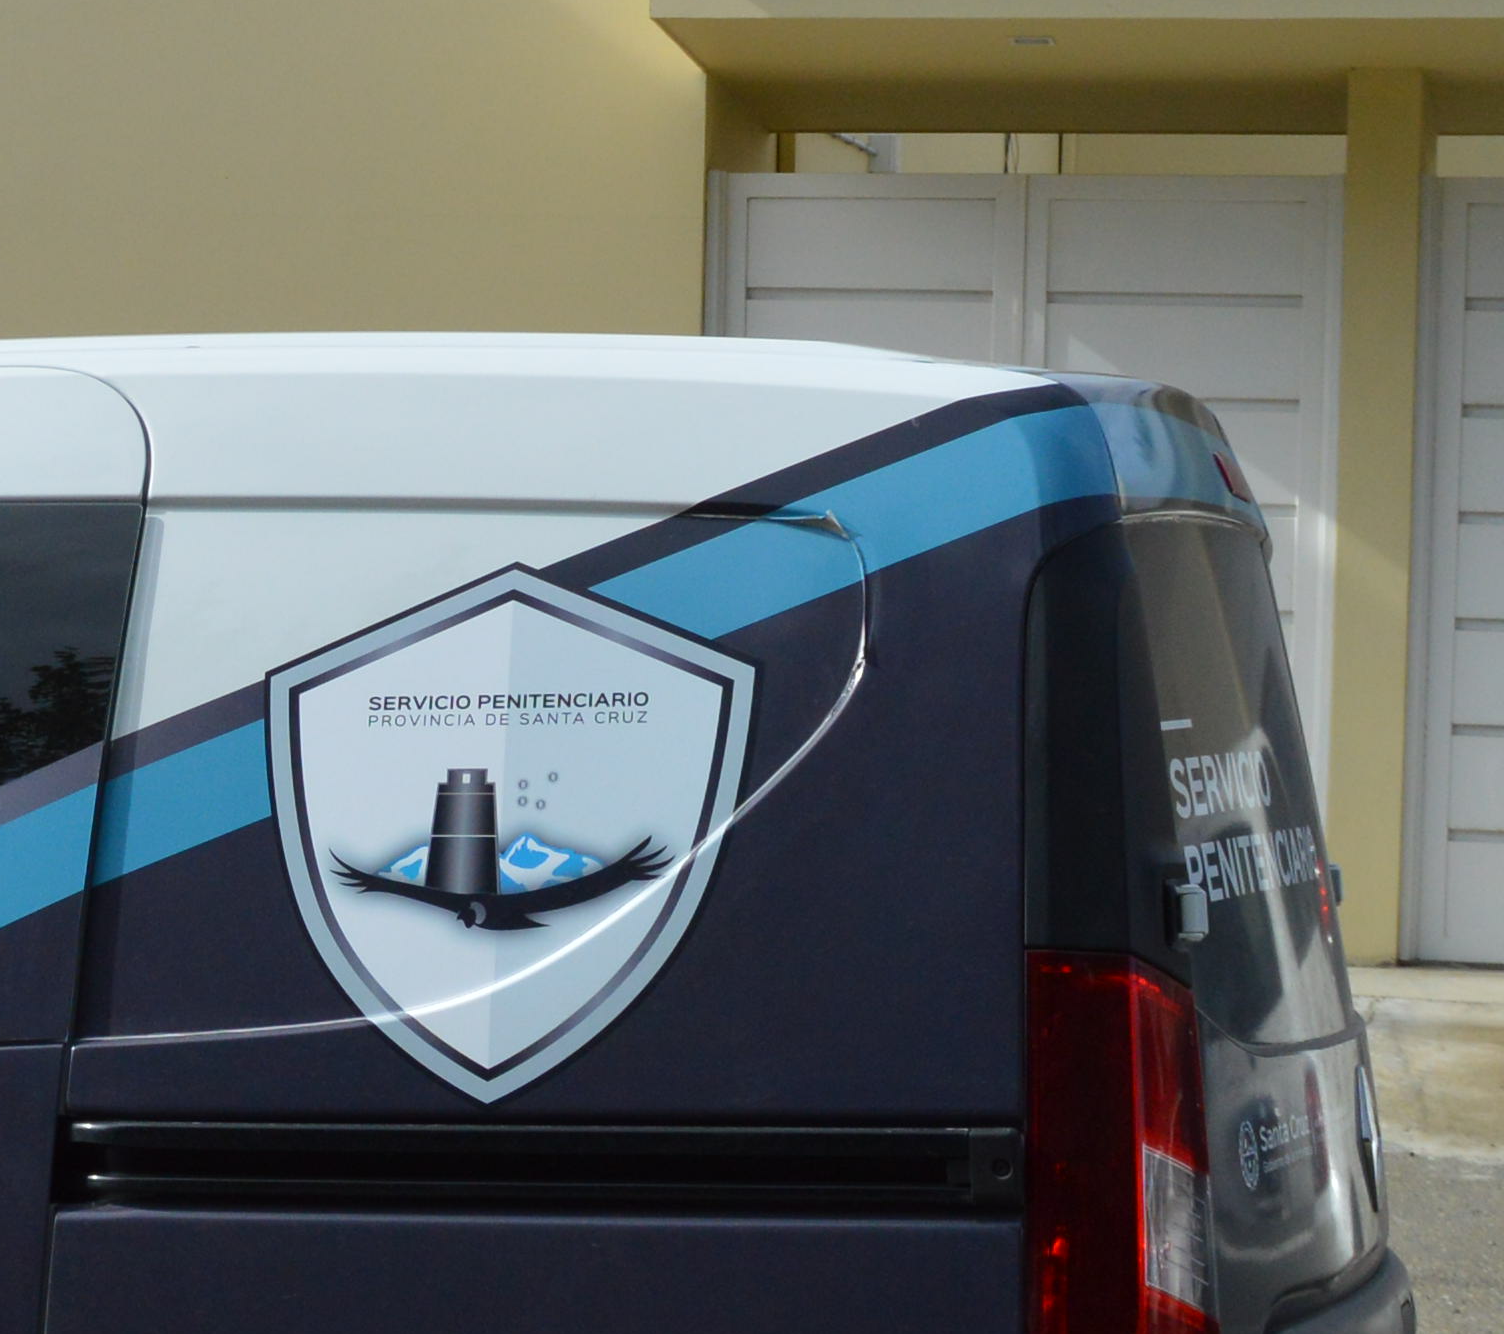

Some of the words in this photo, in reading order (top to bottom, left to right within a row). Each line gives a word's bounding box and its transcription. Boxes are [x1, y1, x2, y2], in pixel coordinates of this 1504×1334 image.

[367, 694, 471, 711] SERVICIO
[477, 691, 650, 710] PENITENCIARIO
[367, 713, 477, 727] PROVINCIA
[485, 713, 510, 727] DE
[519, 711, 585, 725] SANTA
[594, 710, 648, 724] CRUZ
[1169, 749, 1272, 819] SERVICIO
